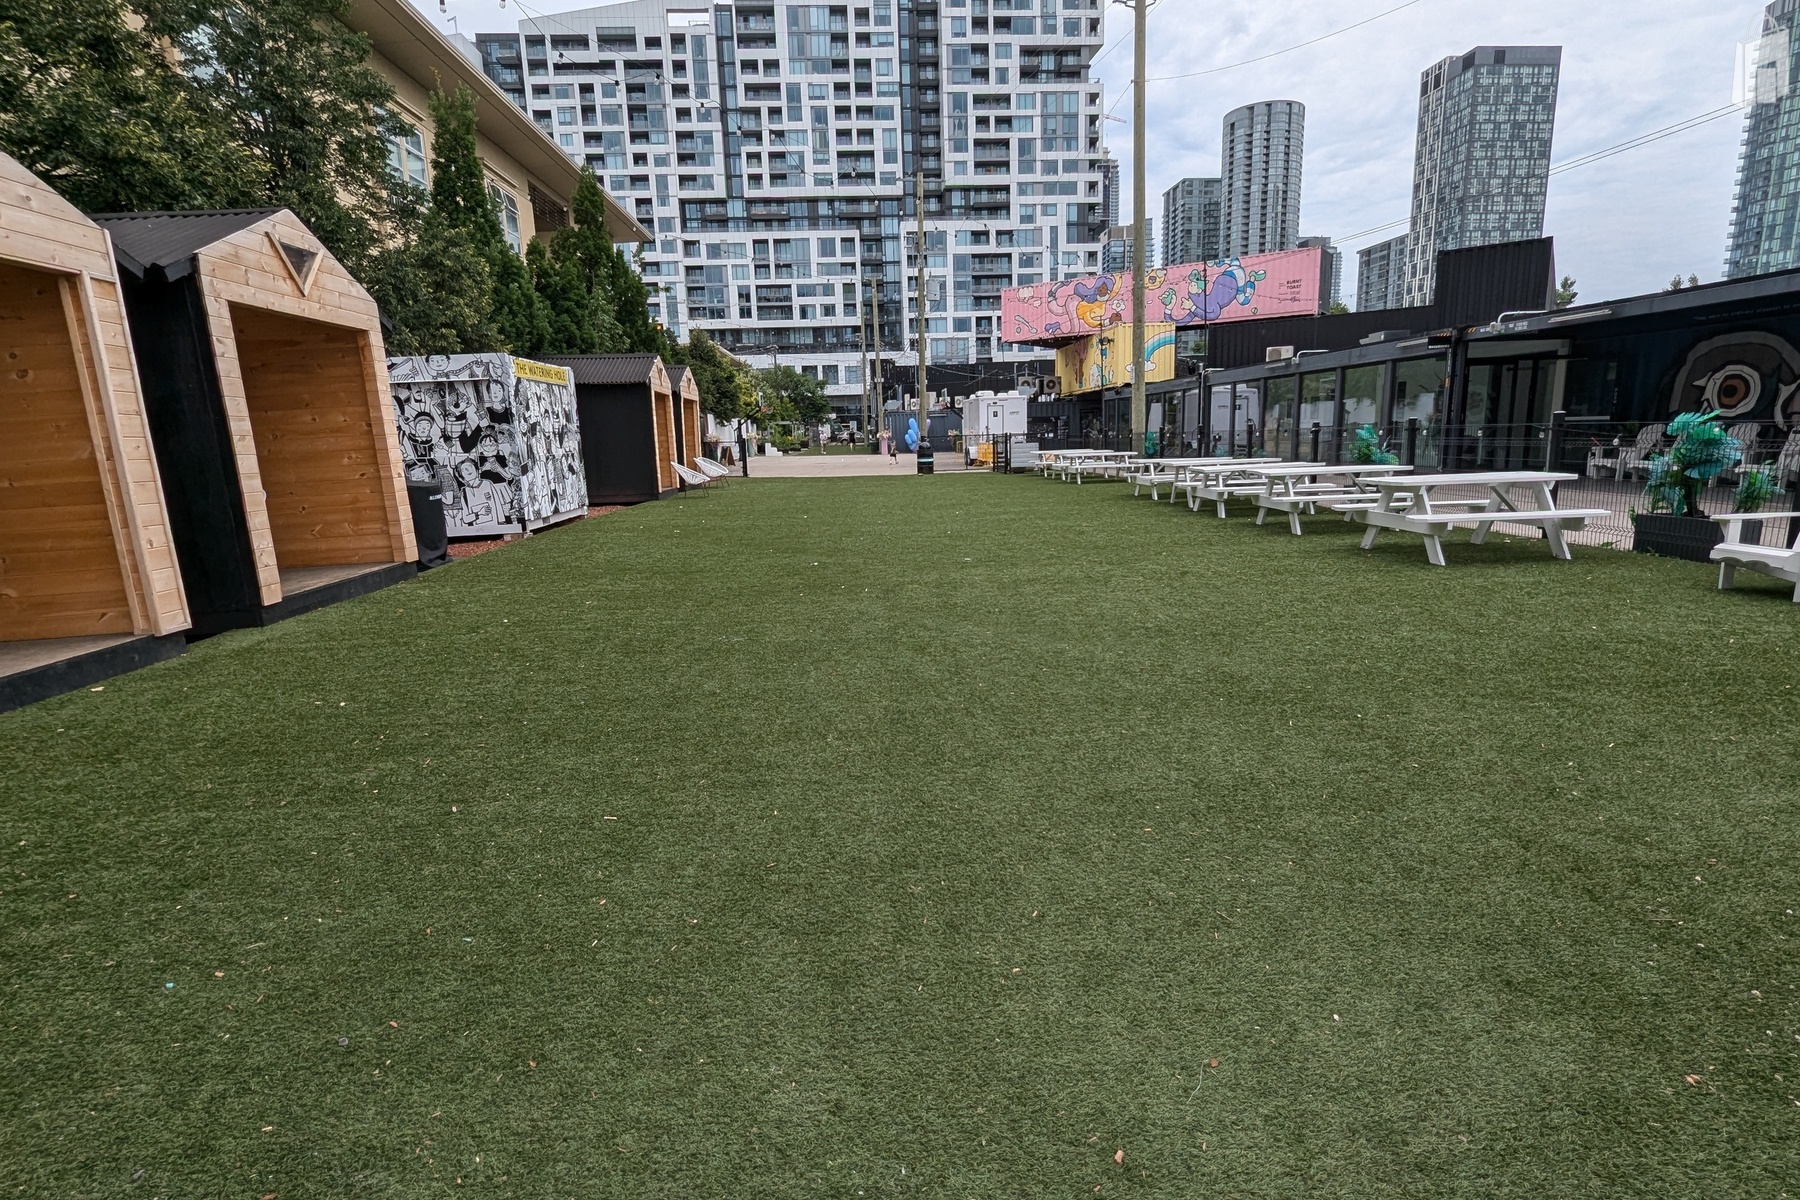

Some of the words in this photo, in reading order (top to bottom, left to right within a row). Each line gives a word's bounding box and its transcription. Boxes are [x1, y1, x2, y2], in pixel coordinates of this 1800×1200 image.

[516, 362, 528, 375] THE
[528, 364, 553, 380] WATERING
[553, 370, 566, 382] HOLE
